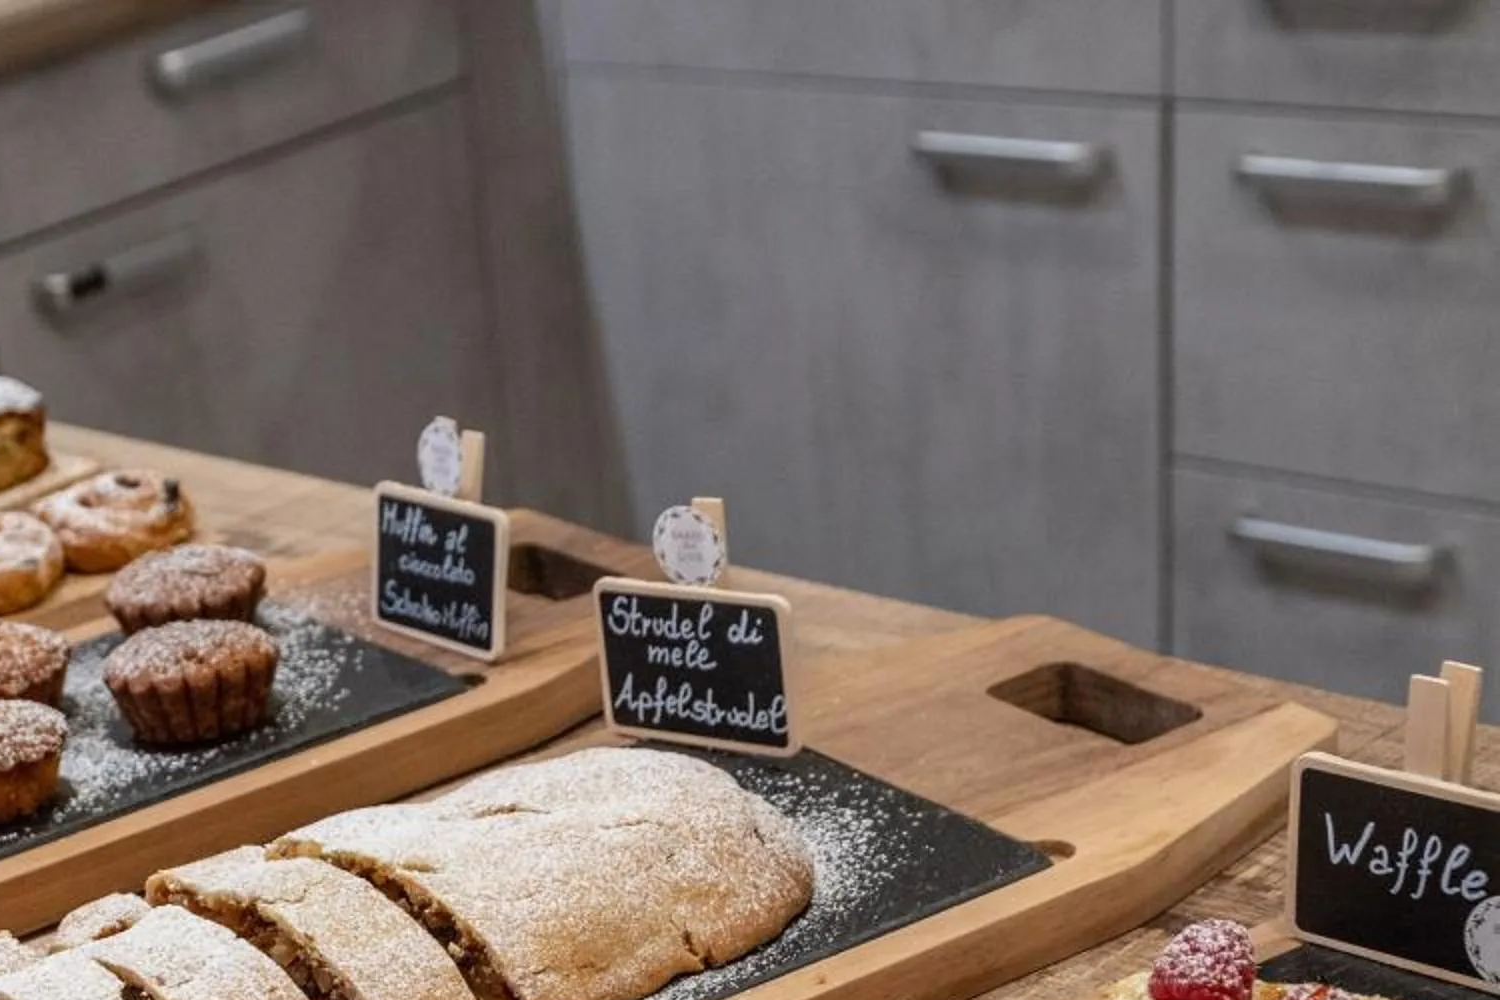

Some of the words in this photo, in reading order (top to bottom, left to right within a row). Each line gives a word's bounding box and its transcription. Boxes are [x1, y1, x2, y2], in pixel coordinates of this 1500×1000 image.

[608, 596, 714, 641] Strudel
[727, 609, 764, 644] di
[648, 640, 718, 670] mele
[614, 671, 788, 734] Apfelstrudel
[1324, 812, 1489, 900] Waffle
